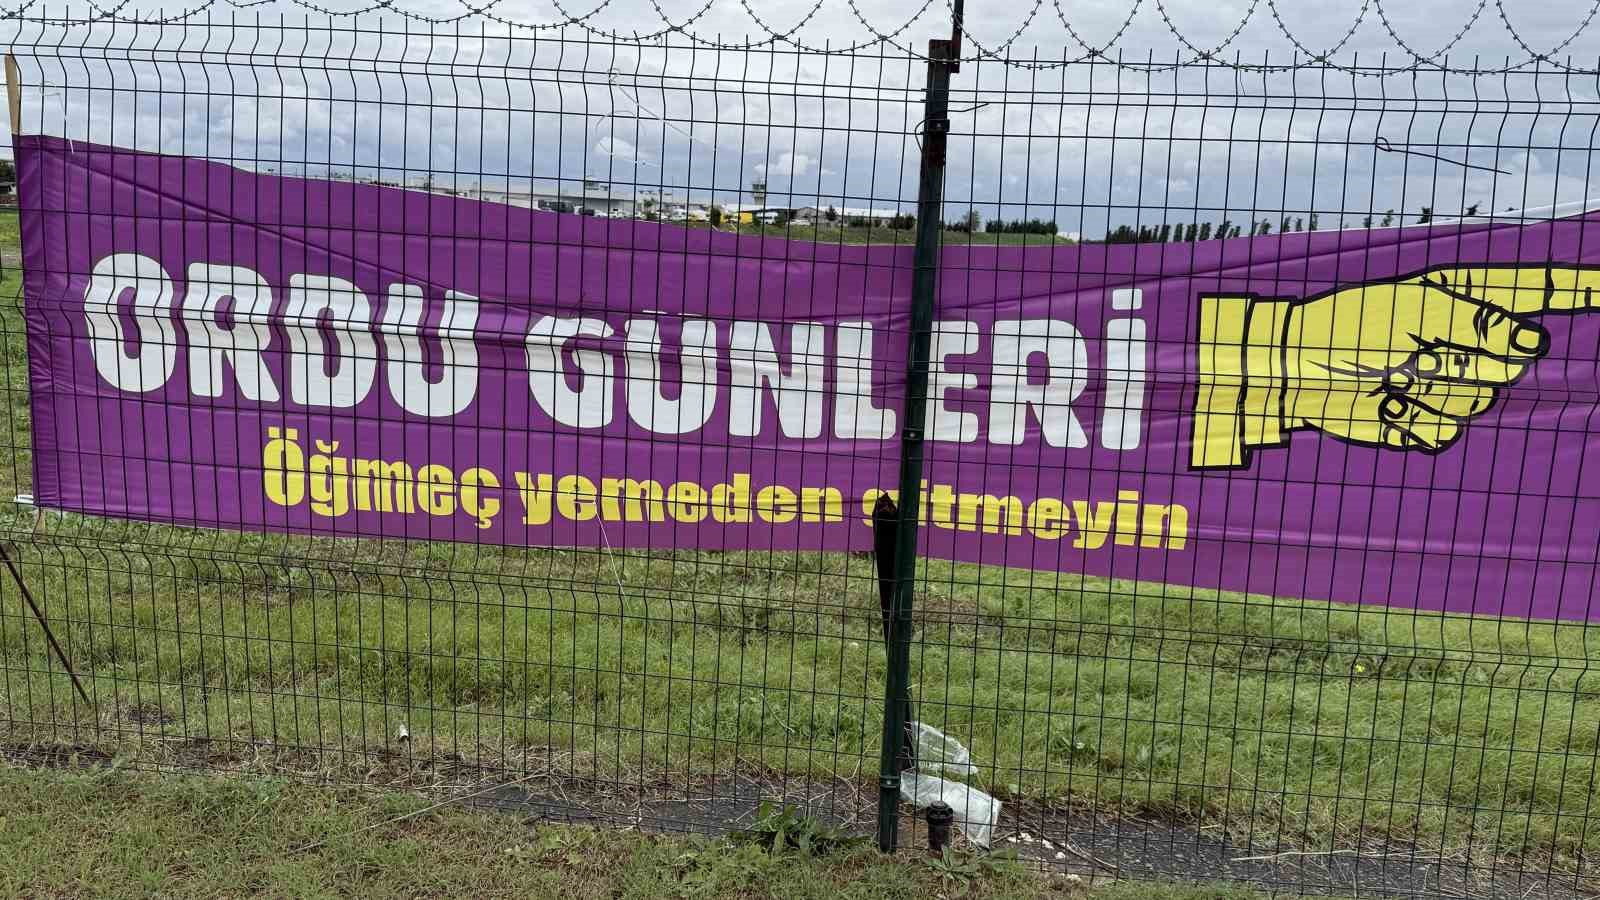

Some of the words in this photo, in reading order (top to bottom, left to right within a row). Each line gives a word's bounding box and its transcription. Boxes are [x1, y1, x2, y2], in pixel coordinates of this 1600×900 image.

[84, 253, 479, 417] ORDU
[263, 426, 501, 529] Öğmeç
[514, 472, 843, 526] yemeden
